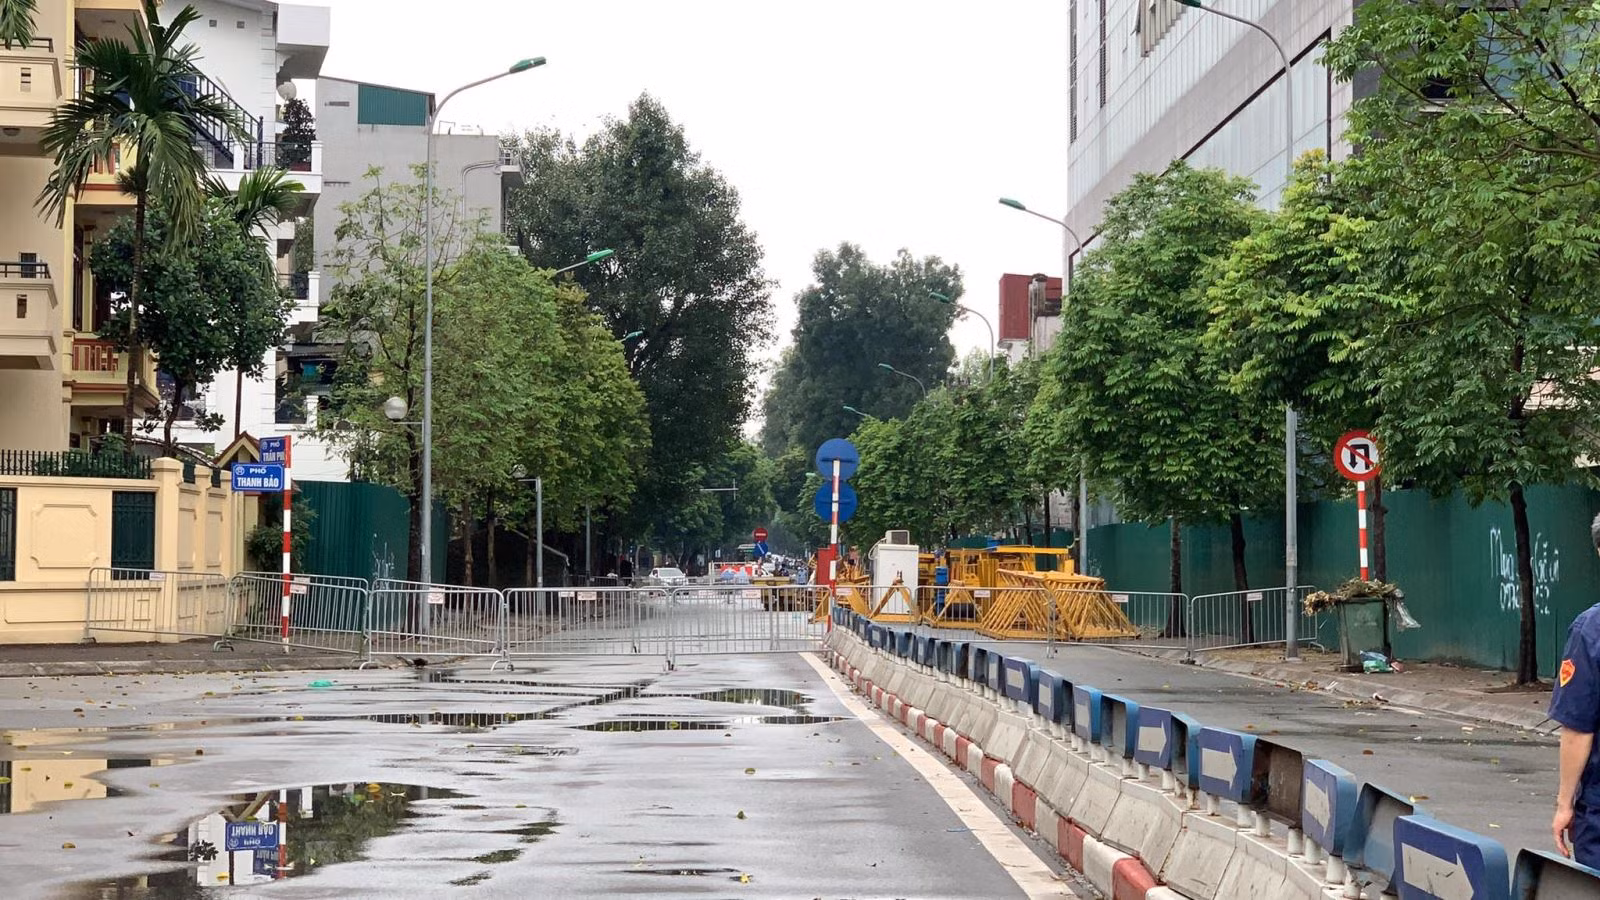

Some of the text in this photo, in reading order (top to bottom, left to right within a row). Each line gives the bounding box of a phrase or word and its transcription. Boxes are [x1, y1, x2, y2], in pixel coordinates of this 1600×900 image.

[249, 466, 267, 474] PHỐ
[237, 474, 279, 487] THANH BẢO
